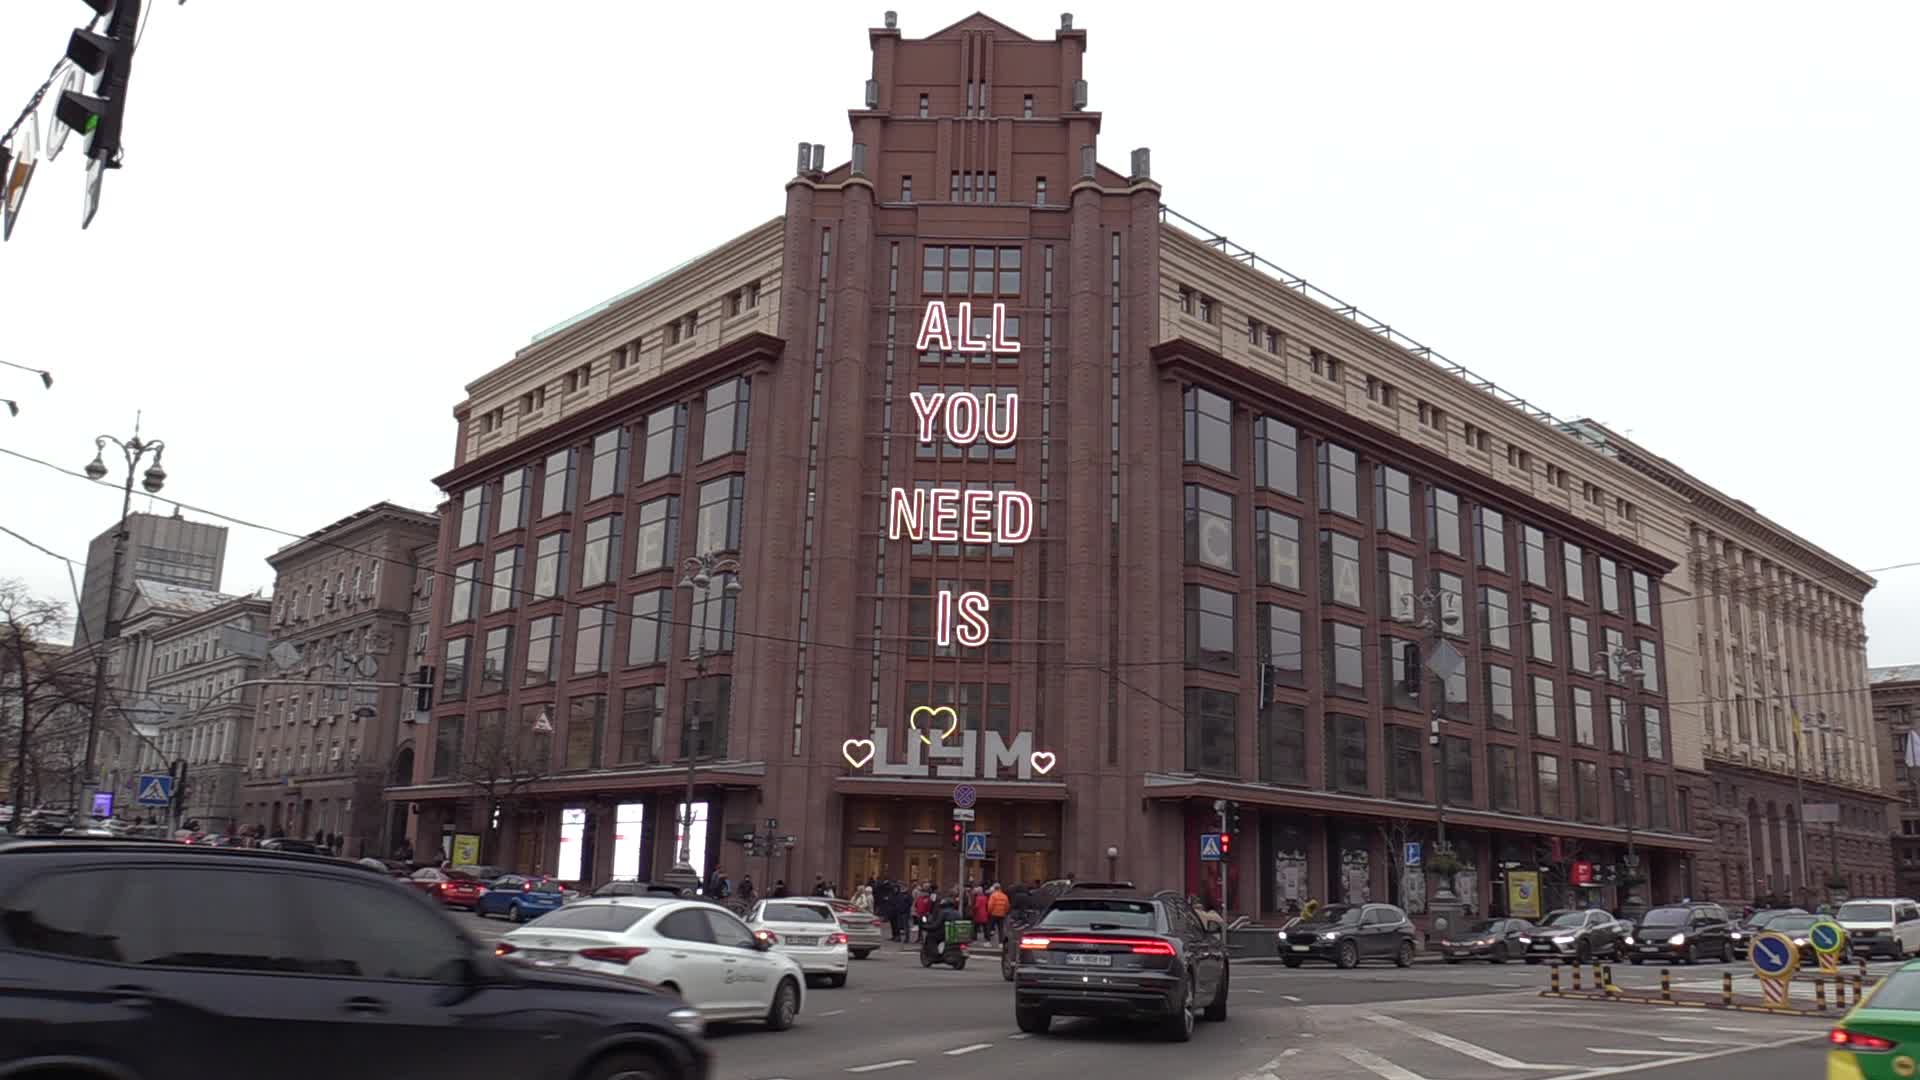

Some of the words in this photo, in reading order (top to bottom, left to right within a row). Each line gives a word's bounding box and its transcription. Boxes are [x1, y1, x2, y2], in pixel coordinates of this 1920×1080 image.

[916, 301, 1021, 352] ALL
[909, 392, 1018, 444] YOU
[889, 488, 1033, 543] NEED
[937, 590, 990, 647] IS
[872, 727, 1033, 780] ЦУМ
